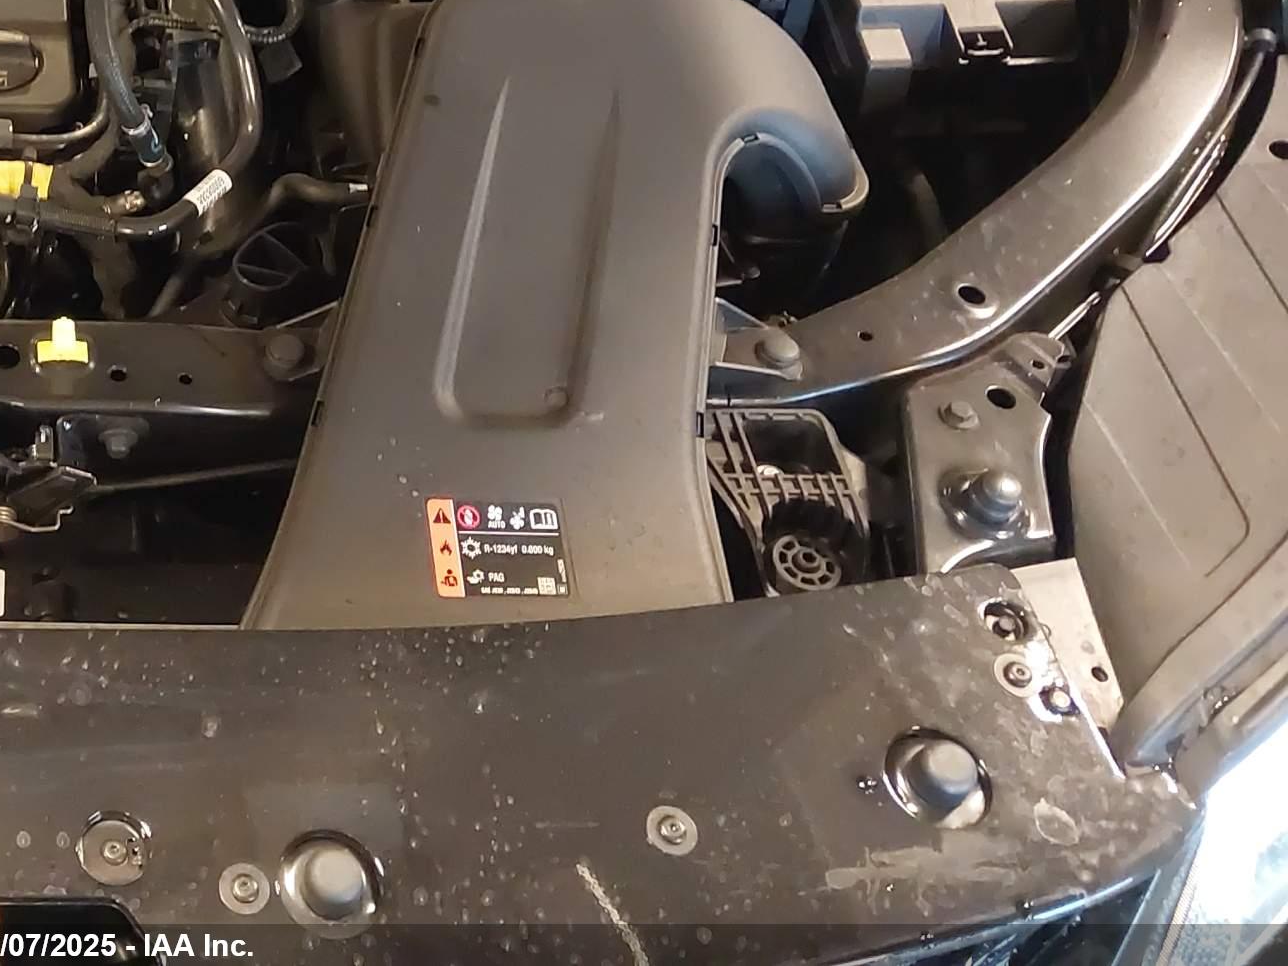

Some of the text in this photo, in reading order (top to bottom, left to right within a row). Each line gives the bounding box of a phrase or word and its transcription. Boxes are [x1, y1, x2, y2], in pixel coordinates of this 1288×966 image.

[487, 520, 506, 529] AUTO
[484, 544, 518, 555] R-1234yf
[543, 544, 555, 557] kg
[488, 572, 505, 583] PAG
